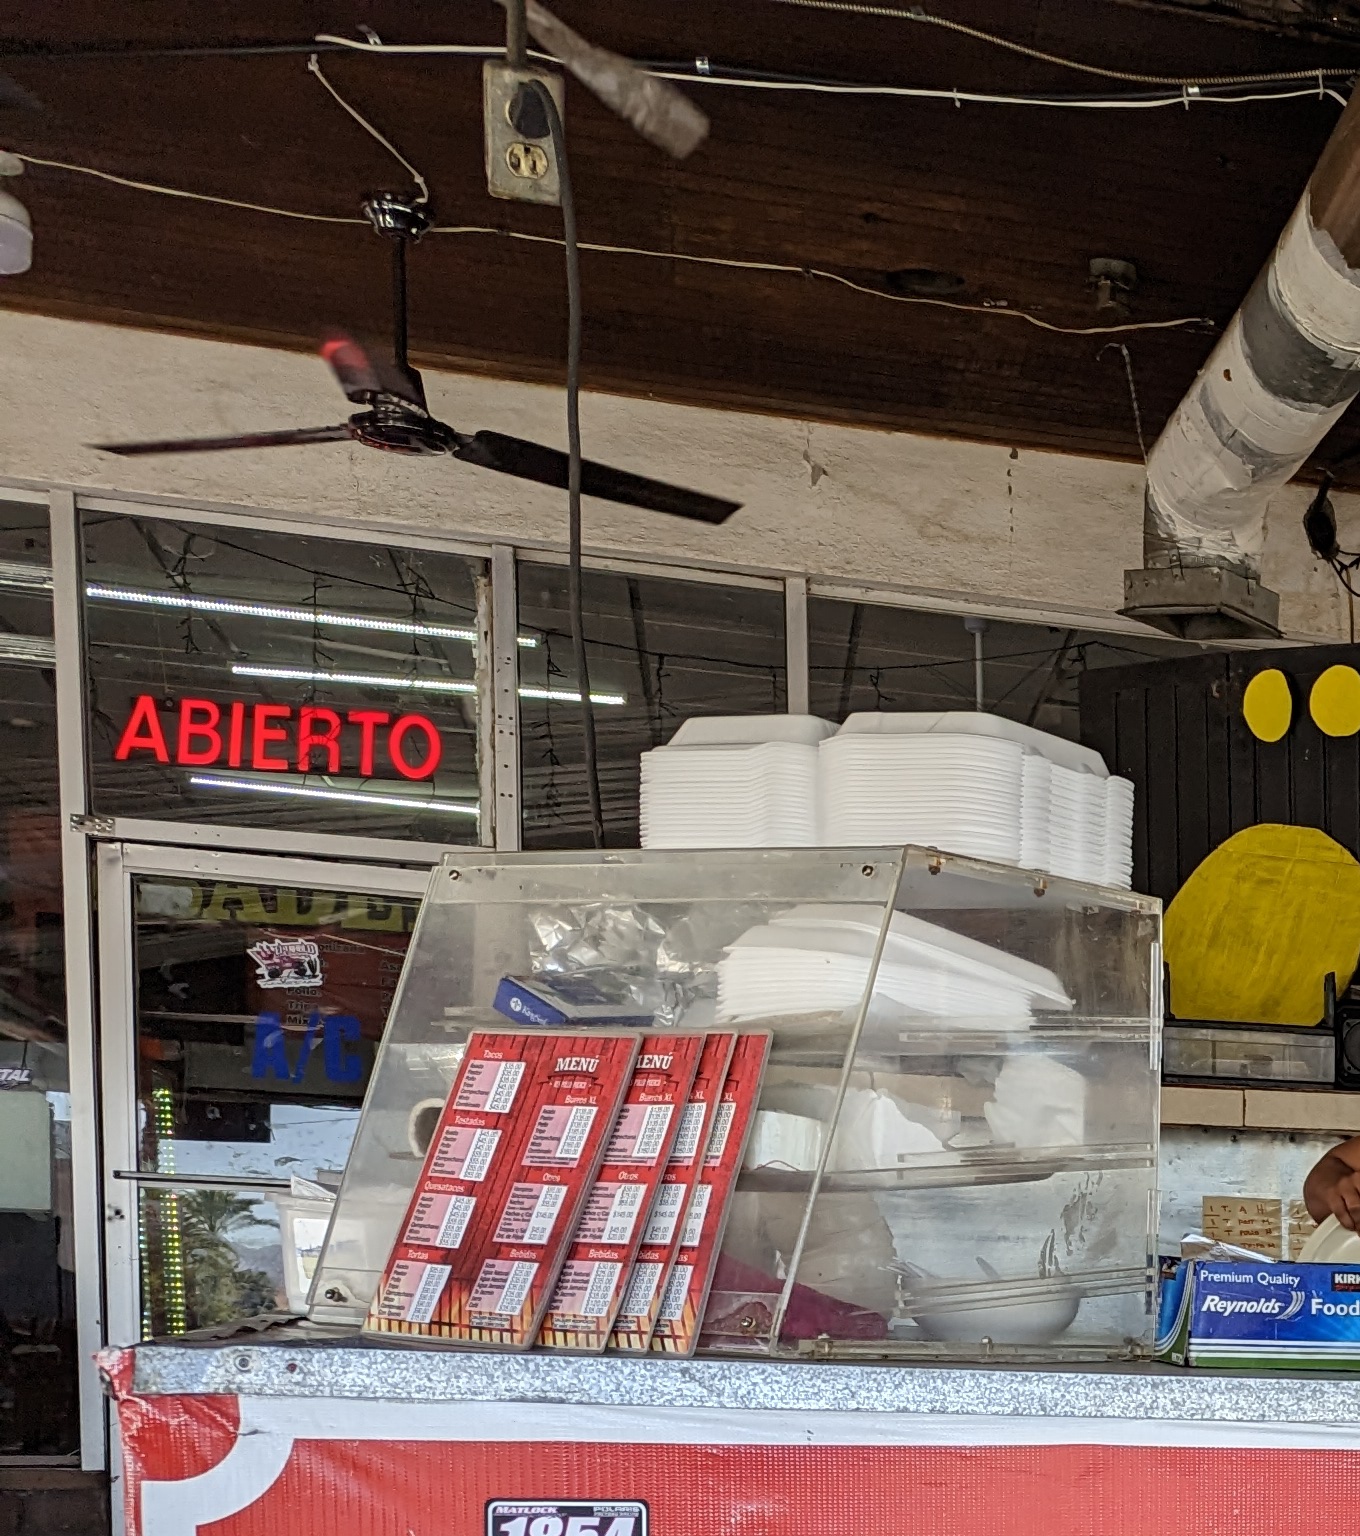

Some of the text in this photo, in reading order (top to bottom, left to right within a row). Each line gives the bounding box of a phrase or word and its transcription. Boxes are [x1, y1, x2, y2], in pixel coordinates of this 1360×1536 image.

[115, 695, 442, 781] ABIERTO
[252, 1010, 363, 1085] A/C
[555, 1055, 600, 1073] MENÚ
[1200, 1270, 1300, 1287] Premium Quality
[1201, 1294, 1281, 1316] Reynolds
[495, 1506, 558, 1514] MATLOCK
